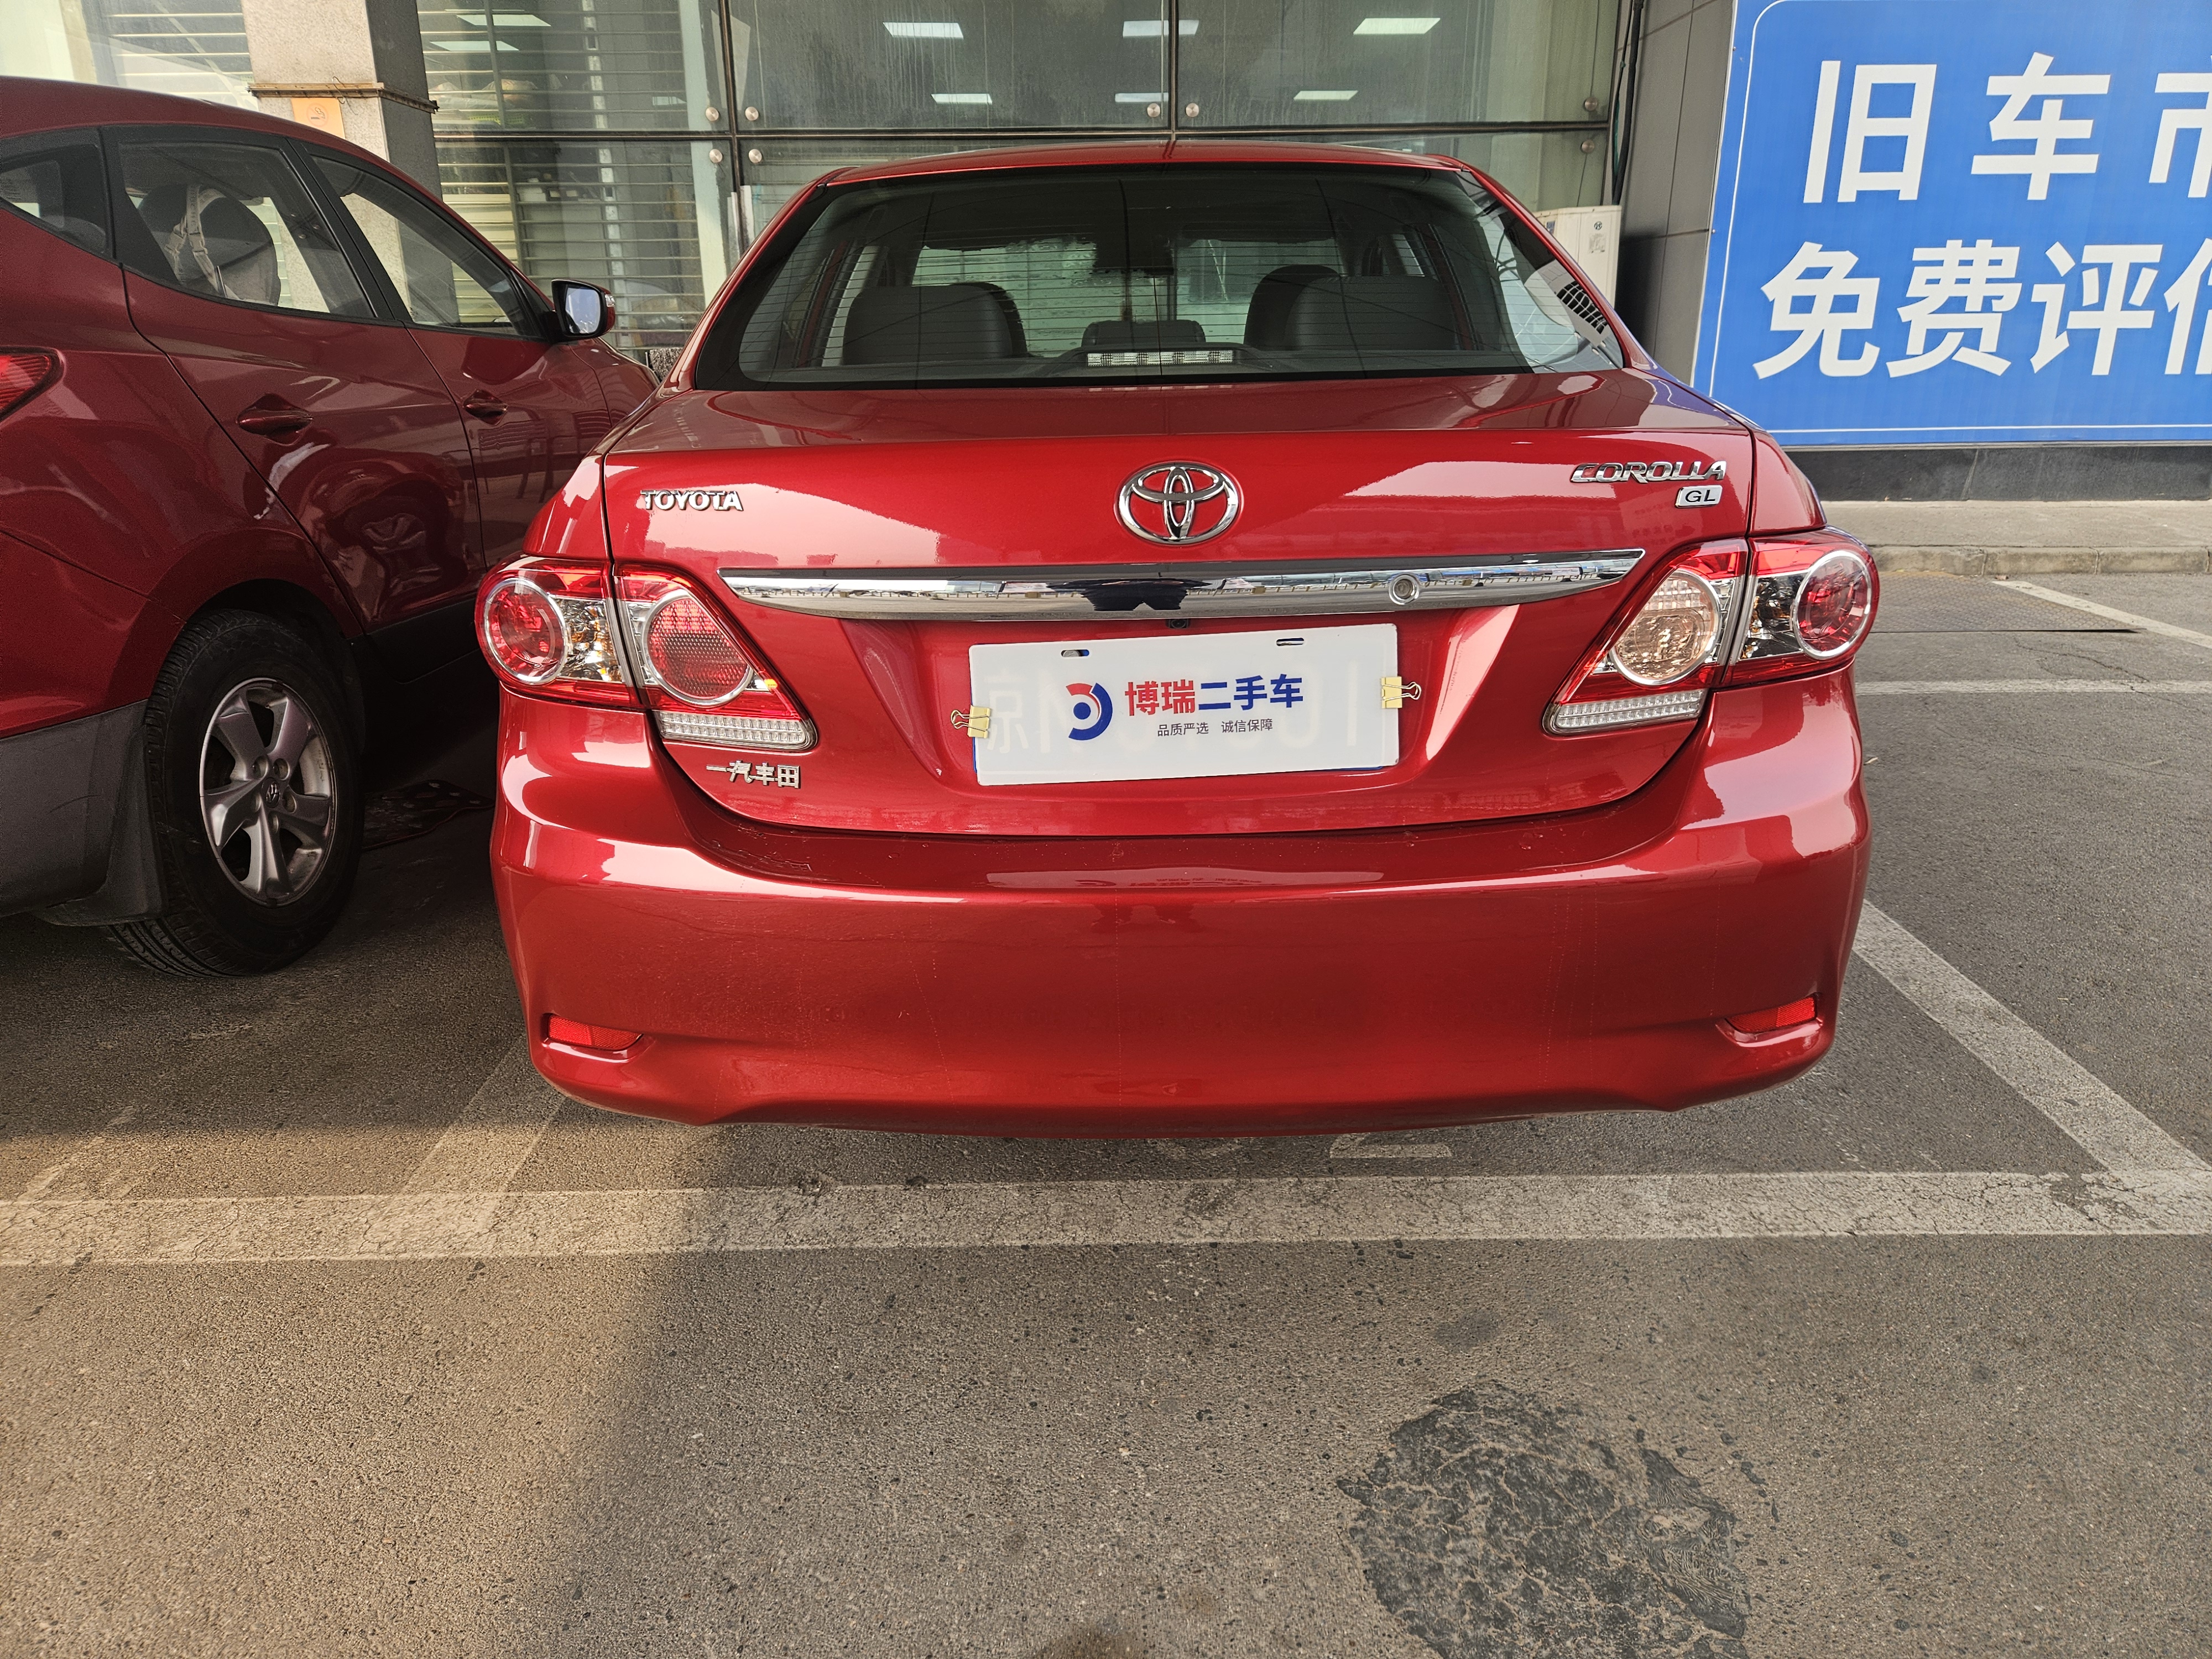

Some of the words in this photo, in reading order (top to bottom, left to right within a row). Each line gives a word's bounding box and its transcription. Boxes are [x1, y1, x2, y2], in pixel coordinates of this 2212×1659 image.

[1570, 460, 1726, 483] COROLLA
[640, 489, 744, 511] TOYOTA
[1685, 490, 1716, 503] GL
[1125, 674, 1303, 716] 博瑞二手车
[1157, 722, 1209, 737] 品质严选
[1220, 718, 1273, 733] 诚信保障
[706, 759, 801, 789] 一汽丰田
